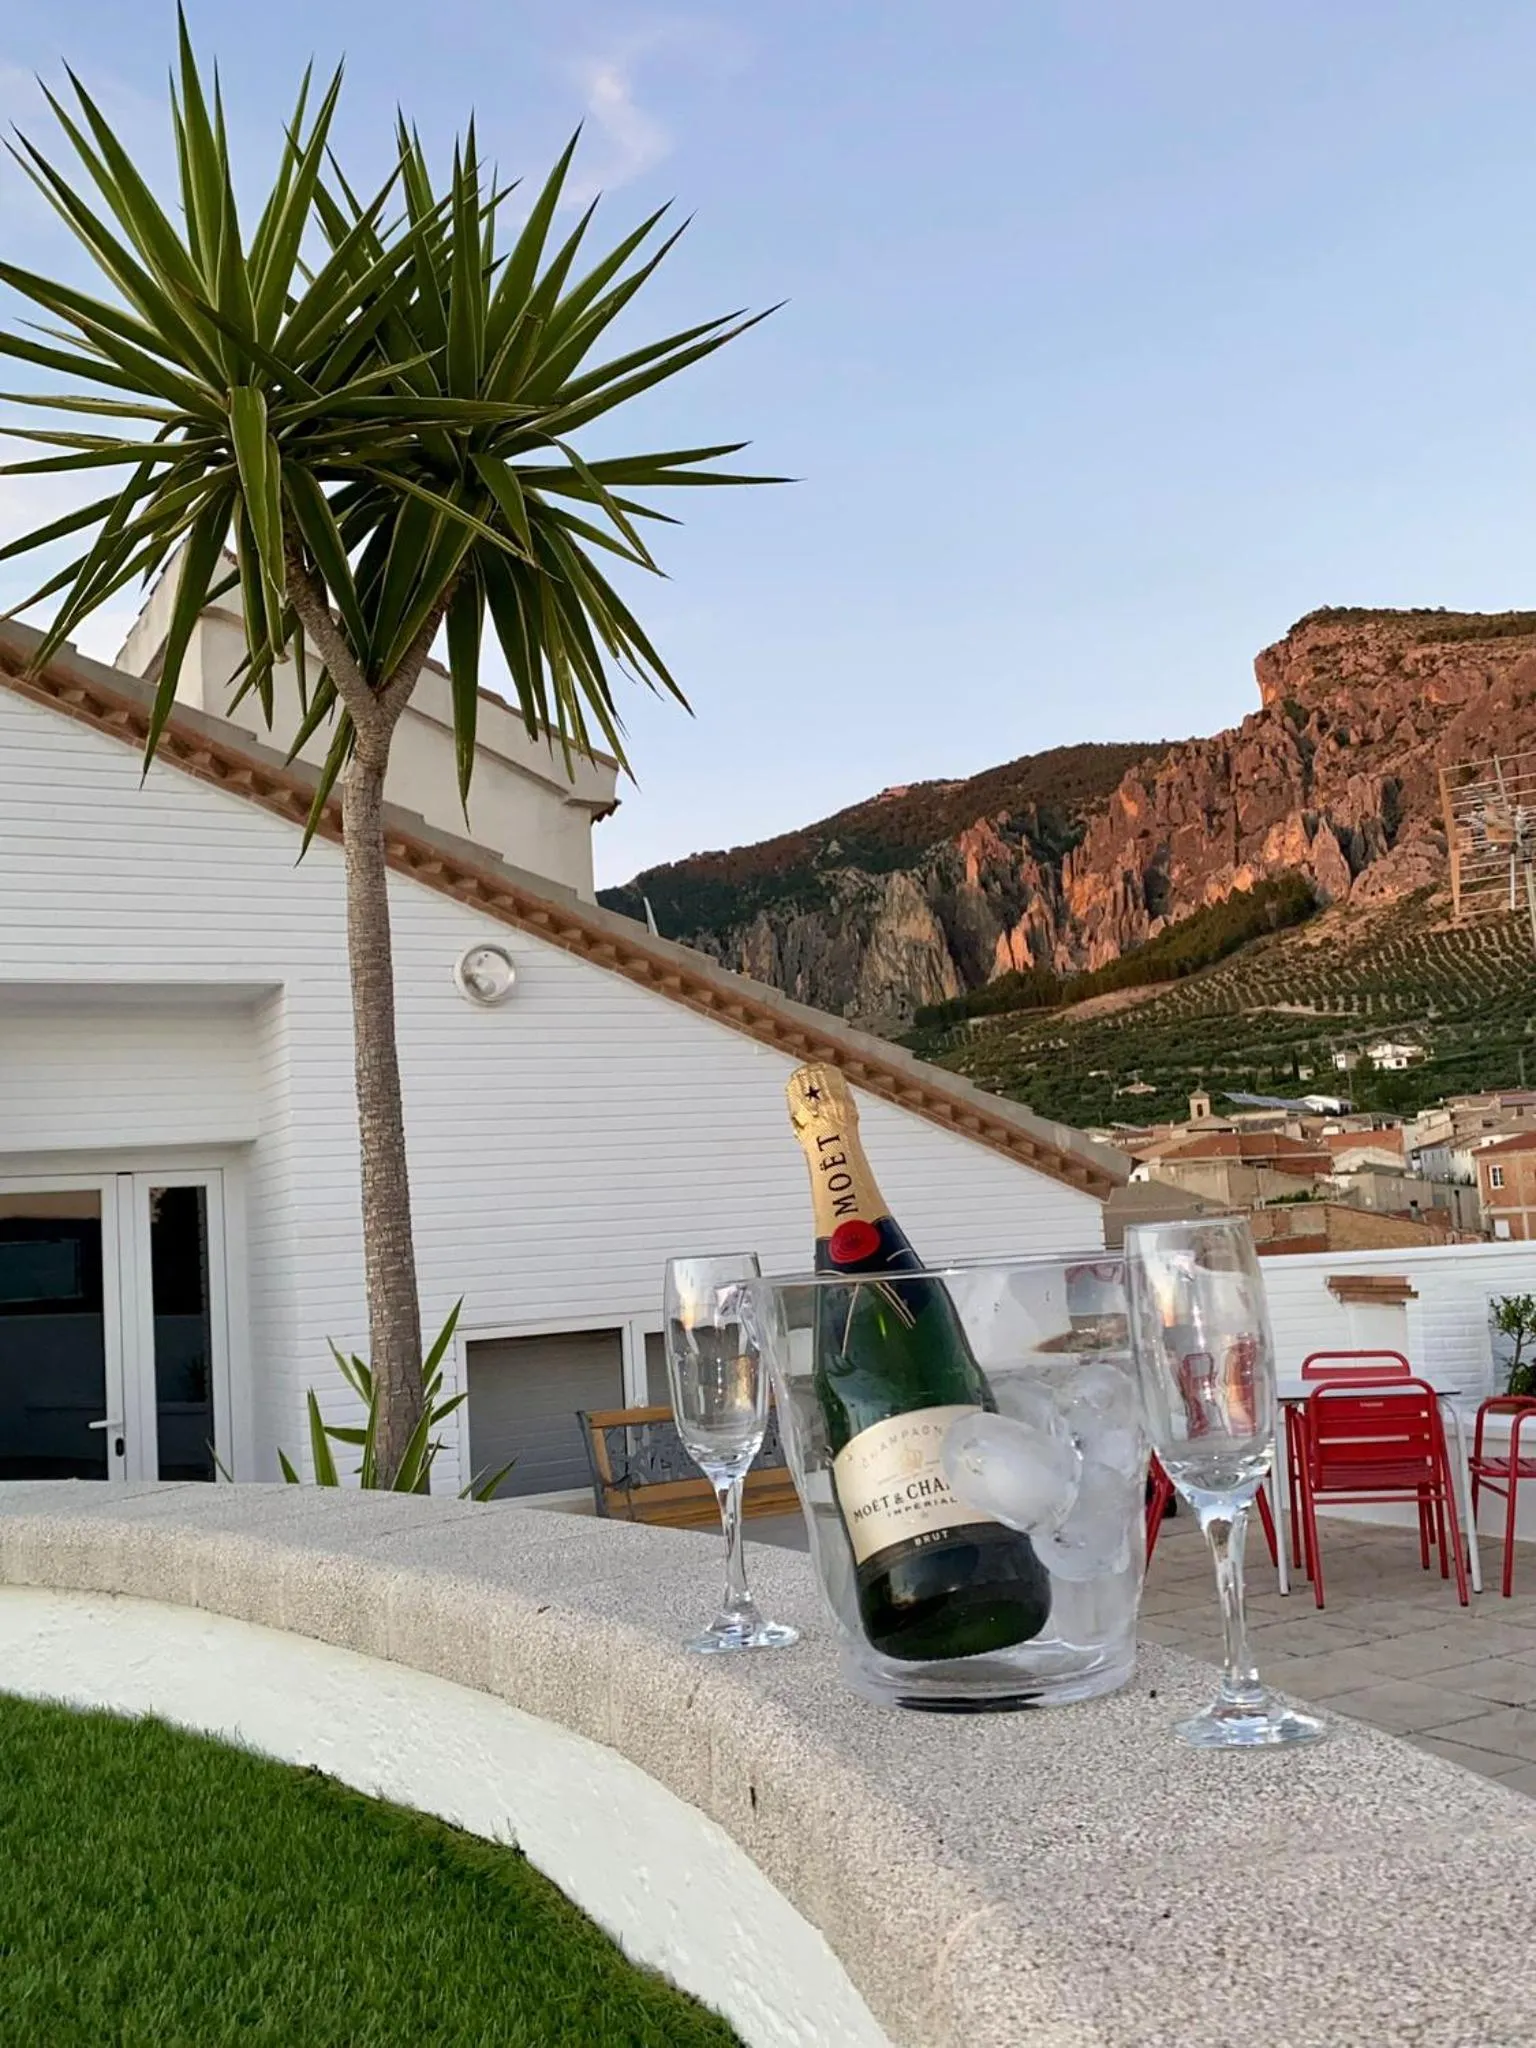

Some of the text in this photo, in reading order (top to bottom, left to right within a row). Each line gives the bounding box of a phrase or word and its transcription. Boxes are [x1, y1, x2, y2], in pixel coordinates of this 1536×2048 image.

[816, 1134, 859, 1217] MOËT
[861, 1424, 943, 1469] CHAMPAGN
[894, 1492, 904, 1505] &
[906, 1477, 950, 1500] CHA
[913, 1529, 949, 1546] BRUT
